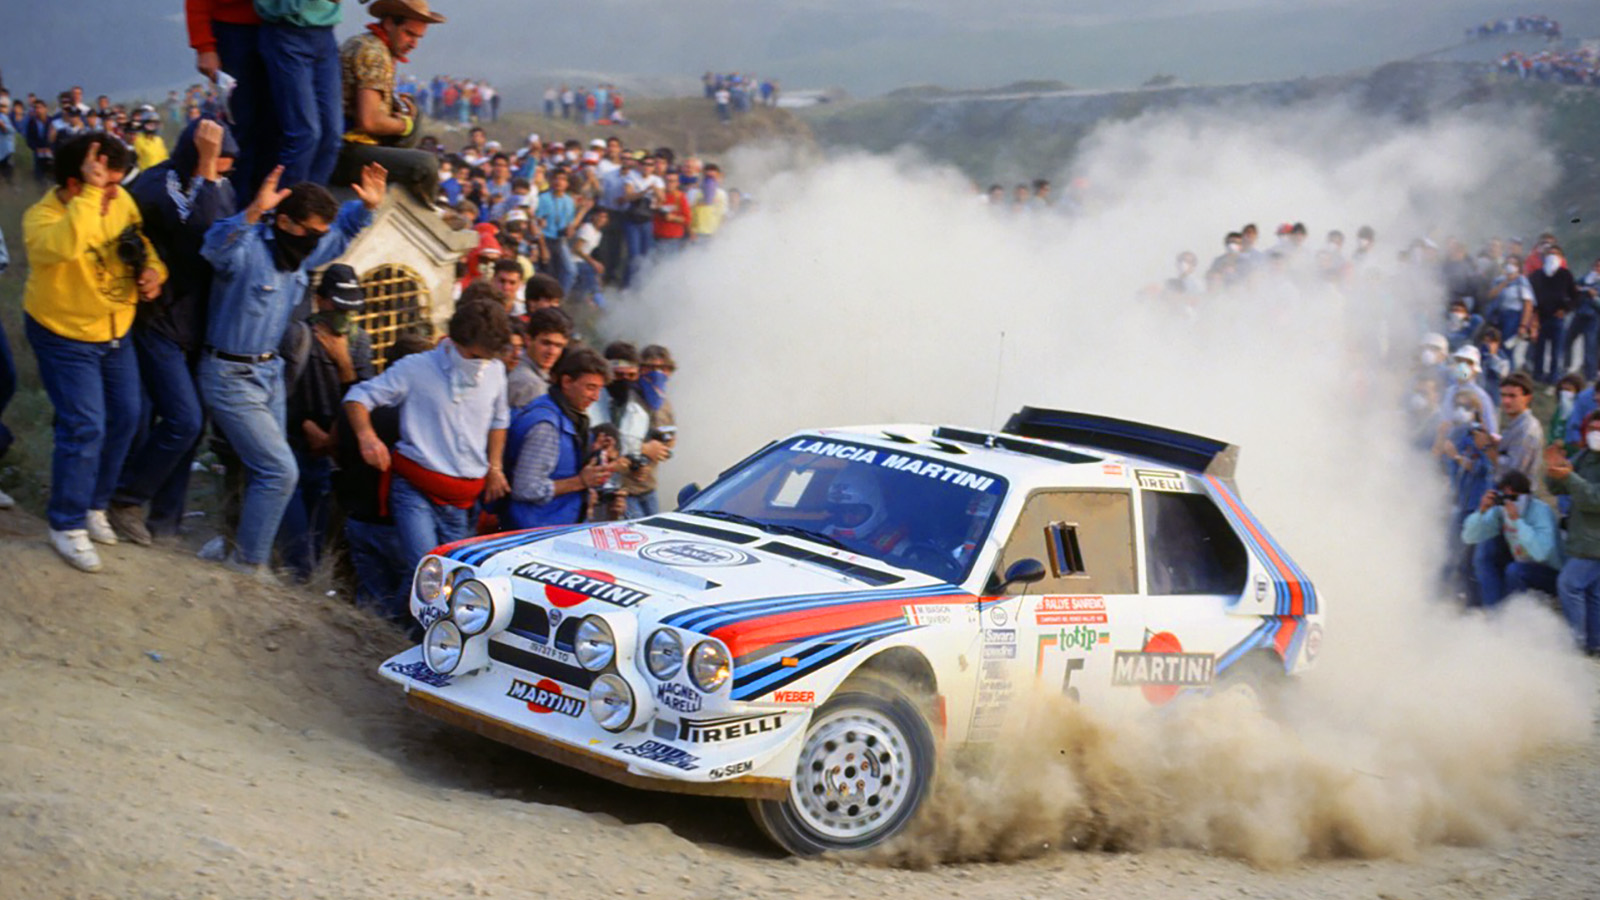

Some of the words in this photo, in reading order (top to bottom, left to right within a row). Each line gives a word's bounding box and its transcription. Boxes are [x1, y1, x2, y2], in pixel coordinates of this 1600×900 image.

[790, 438, 874, 464] LANCIA
[880, 453, 995, 492] MARTINI
[1134, 468, 1184, 491] PIRELLI
[517, 562, 644, 606] MARTINI
[1044, 598, 1070, 610] RALLYE
[1072, 597, 1105, 610] SANREMO
[1062, 658, 1085, 703] 5
[1115, 655, 1212, 682] MARTINI
[511, 682, 583, 718] MARTINI
[774, 691, 815, 703] WEBER
[678, 710, 787, 744] PIRELLI
[725, 760, 753, 776] SIEM
